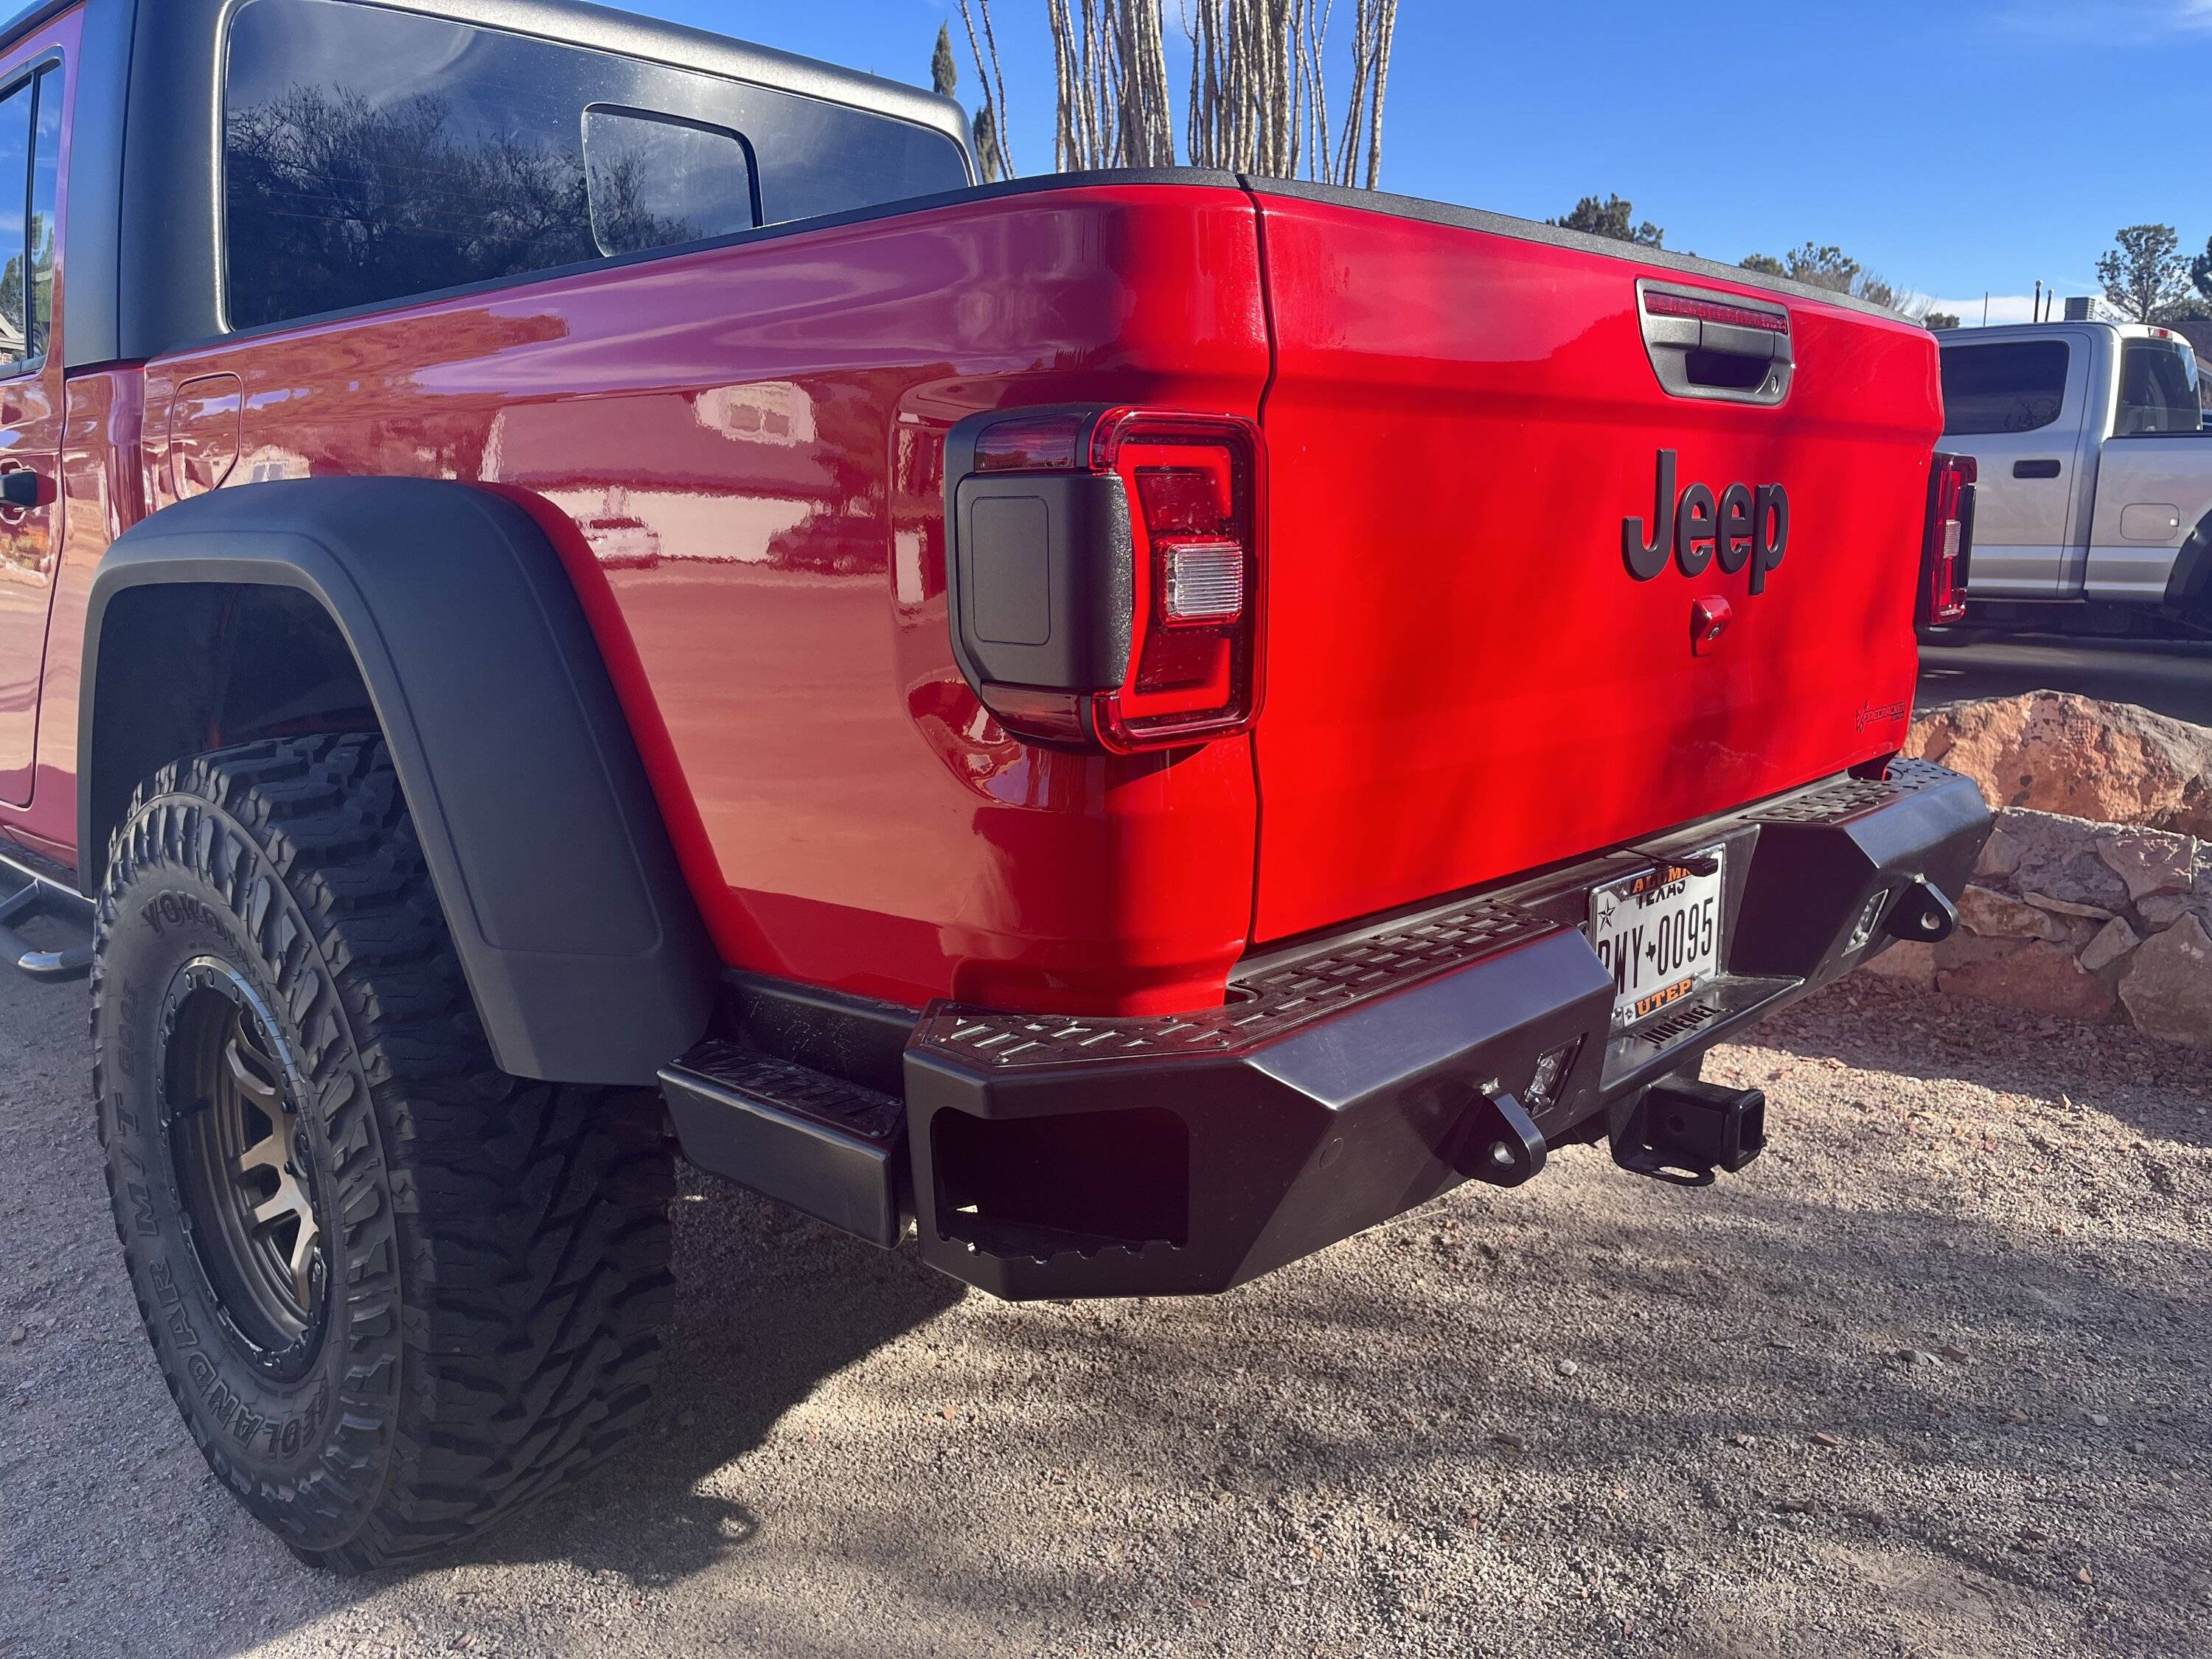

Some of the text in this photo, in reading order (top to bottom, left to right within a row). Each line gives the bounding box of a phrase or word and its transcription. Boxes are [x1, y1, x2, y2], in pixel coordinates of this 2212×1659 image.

[1621, 448, 1790, 597] Jeep
[1658, 897, 1714, 976] 0095
[1636, 979, 1692, 1016] UTEP
